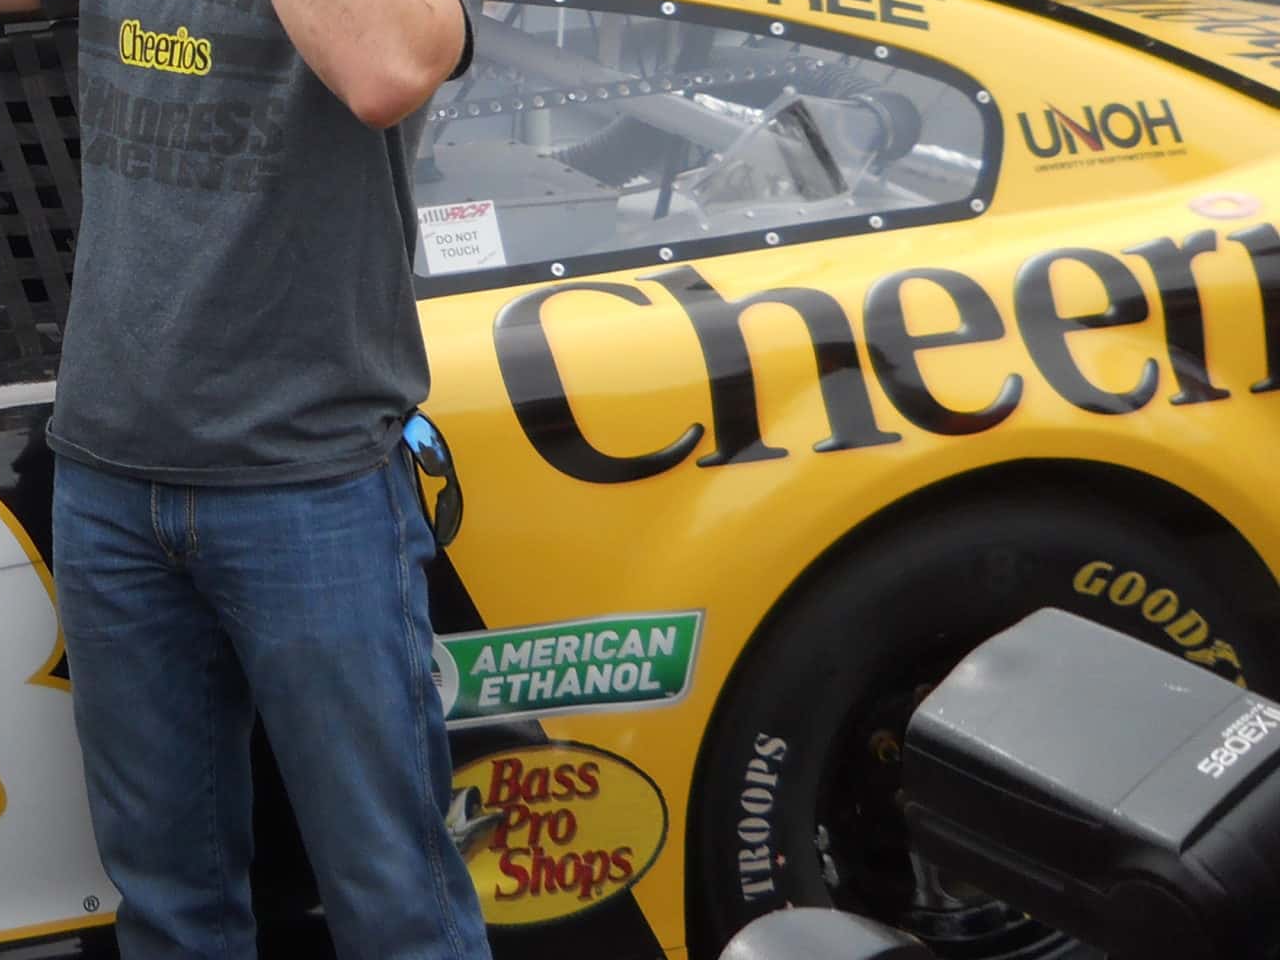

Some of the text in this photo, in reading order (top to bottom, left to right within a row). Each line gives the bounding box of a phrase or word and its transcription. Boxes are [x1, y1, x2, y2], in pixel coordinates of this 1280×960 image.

[120, 22, 211, 72] Cheerios
[1016, 98, 1184, 160] UNOH
[435, 233, 453, 245] DO
[455, 231, 479, 242] NOT
[439, 245, 480, 258] TOUCH
[470, 625, 677, 675] AMERICAN
[477, 660, 661, 707] ETHANOL
[484, 757, 601, 809] Bass
[488, 803, 578, 852] Pro
[737, 732, 789, 902] TROOPS
[494, 846, 634, 903] Shops
